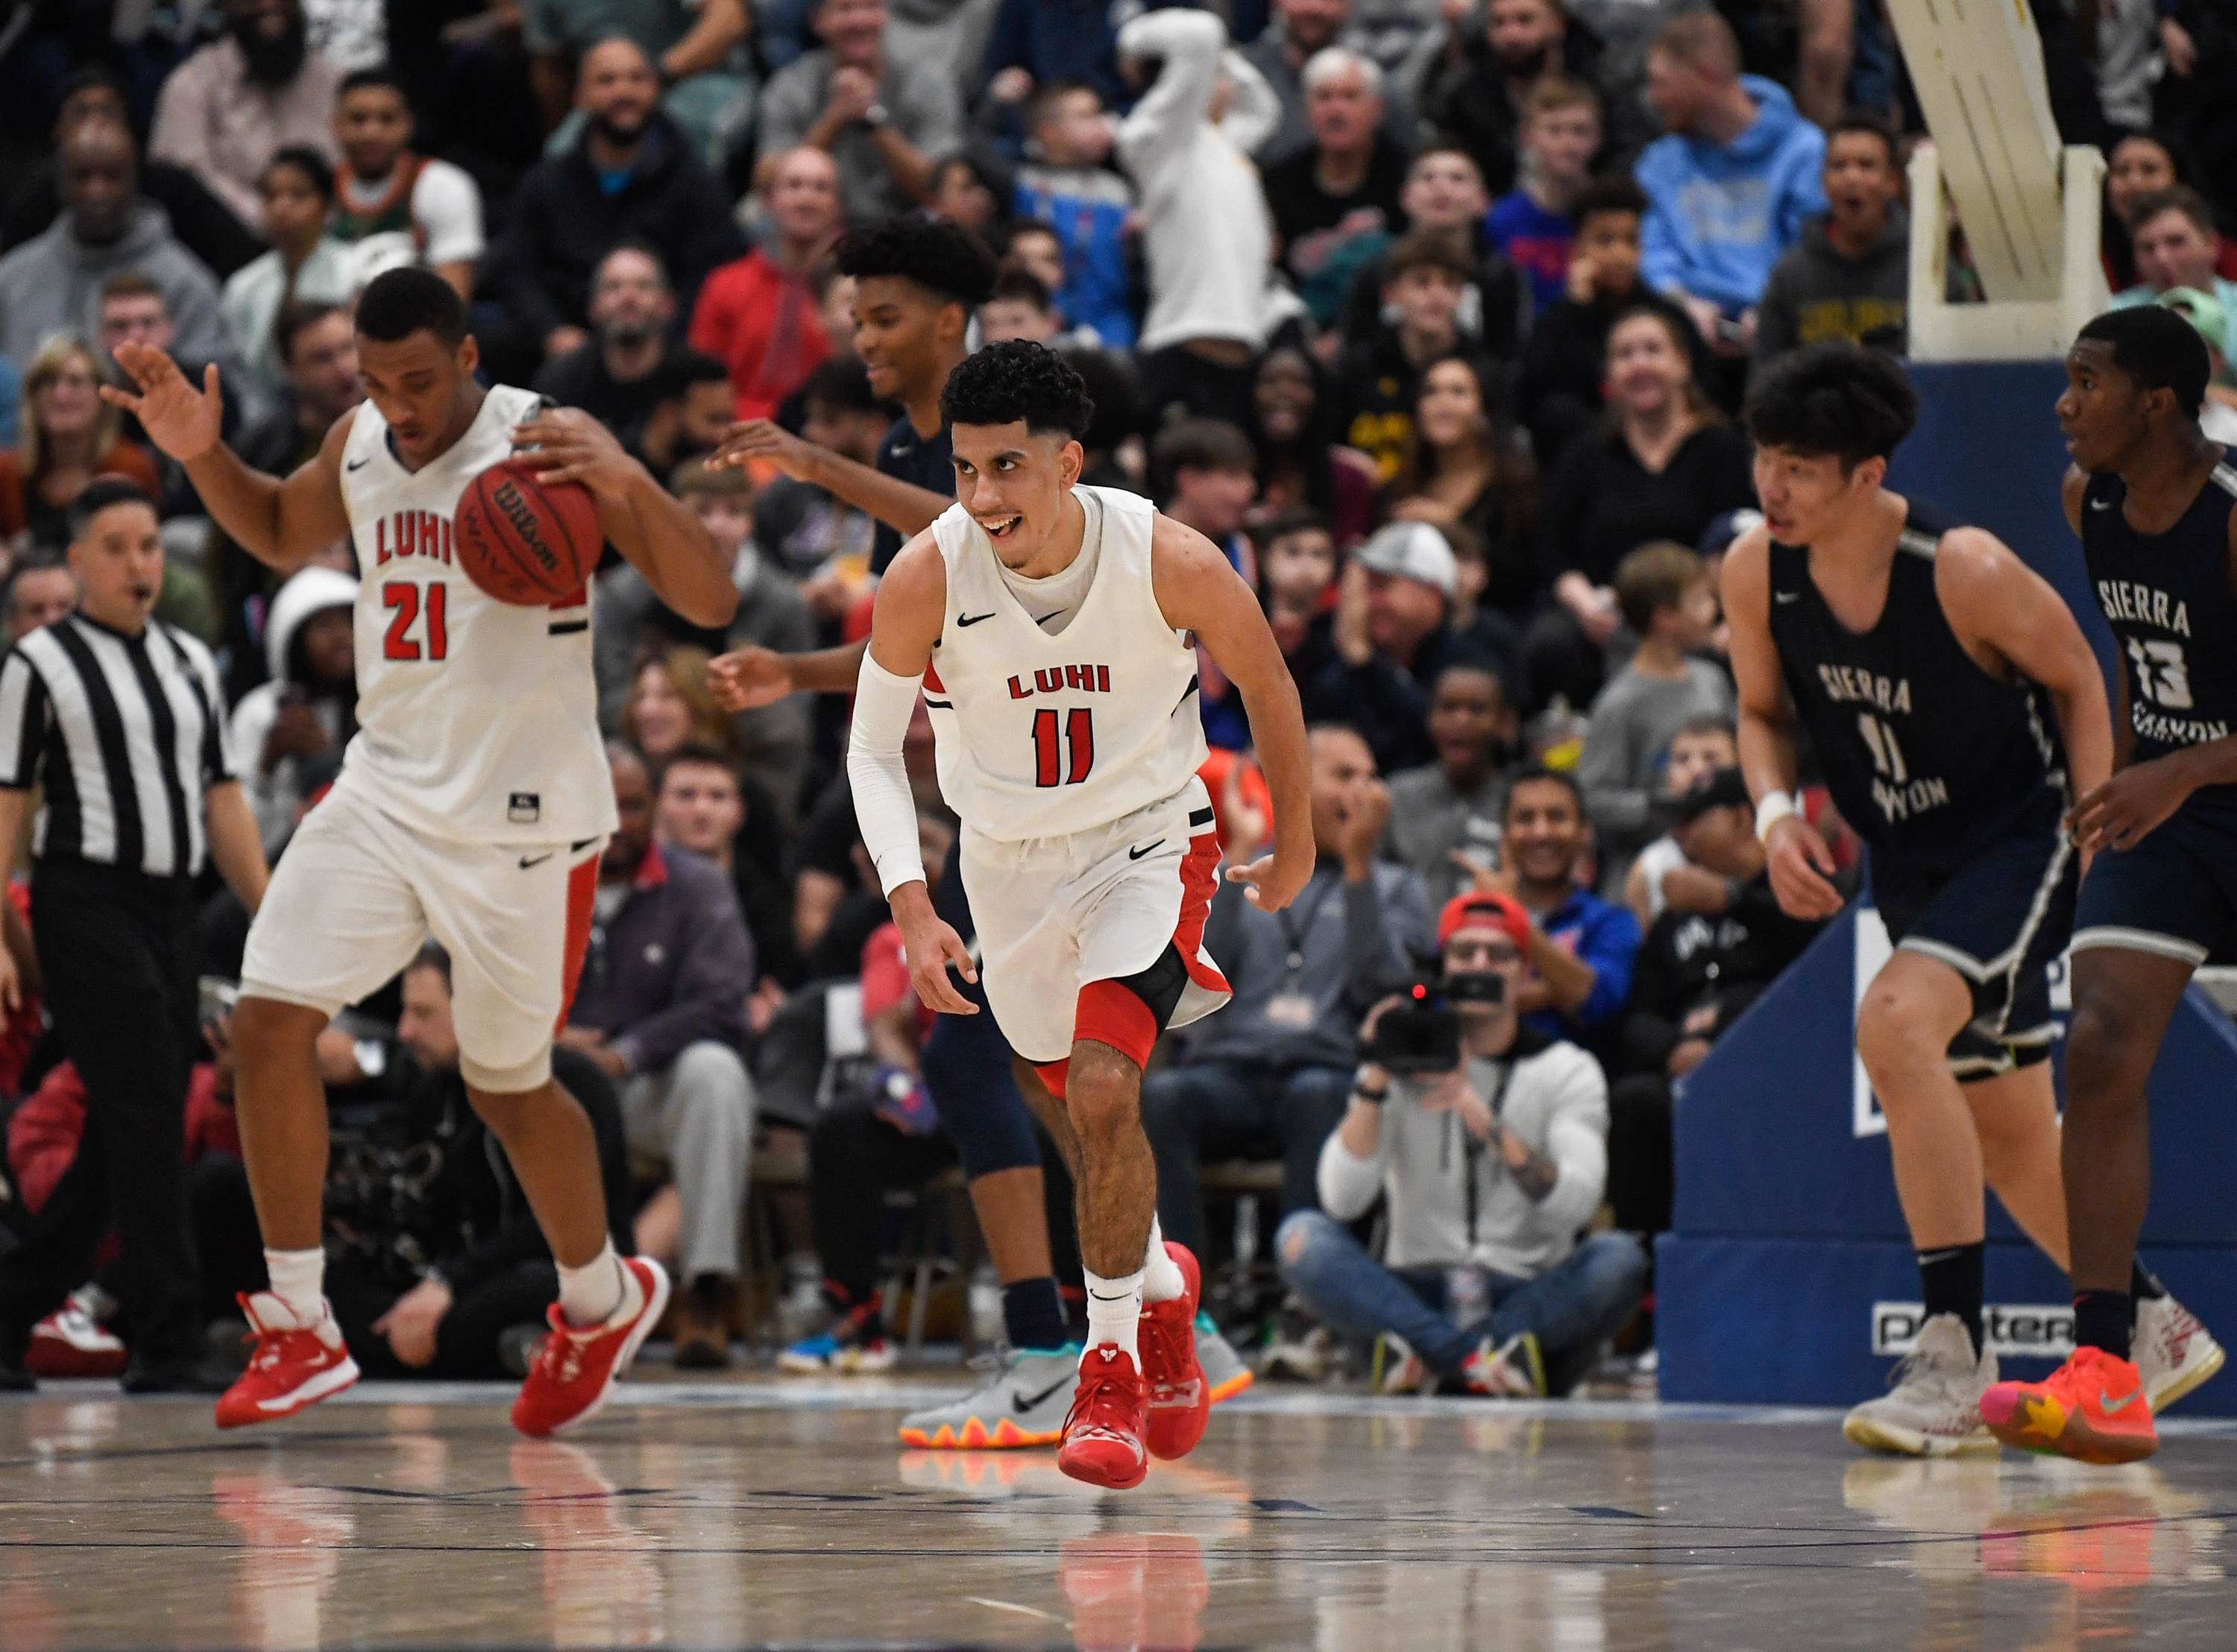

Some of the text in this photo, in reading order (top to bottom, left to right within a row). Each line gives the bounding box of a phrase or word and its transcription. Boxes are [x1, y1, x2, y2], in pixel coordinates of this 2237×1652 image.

[377, 510, 450, 567] LUHI
[492, 481, 557, 572] Wilson
[383, 581, 448, 661] 21
[2098, 579, 2192, 638] SIERRA
[1007, 664, 1110, 699] LUHI
[1817, 663, 1911, 714] SIERRA
[2127, 635, 2194, 709] 13
[1031, 707, 1095, 787] 11
